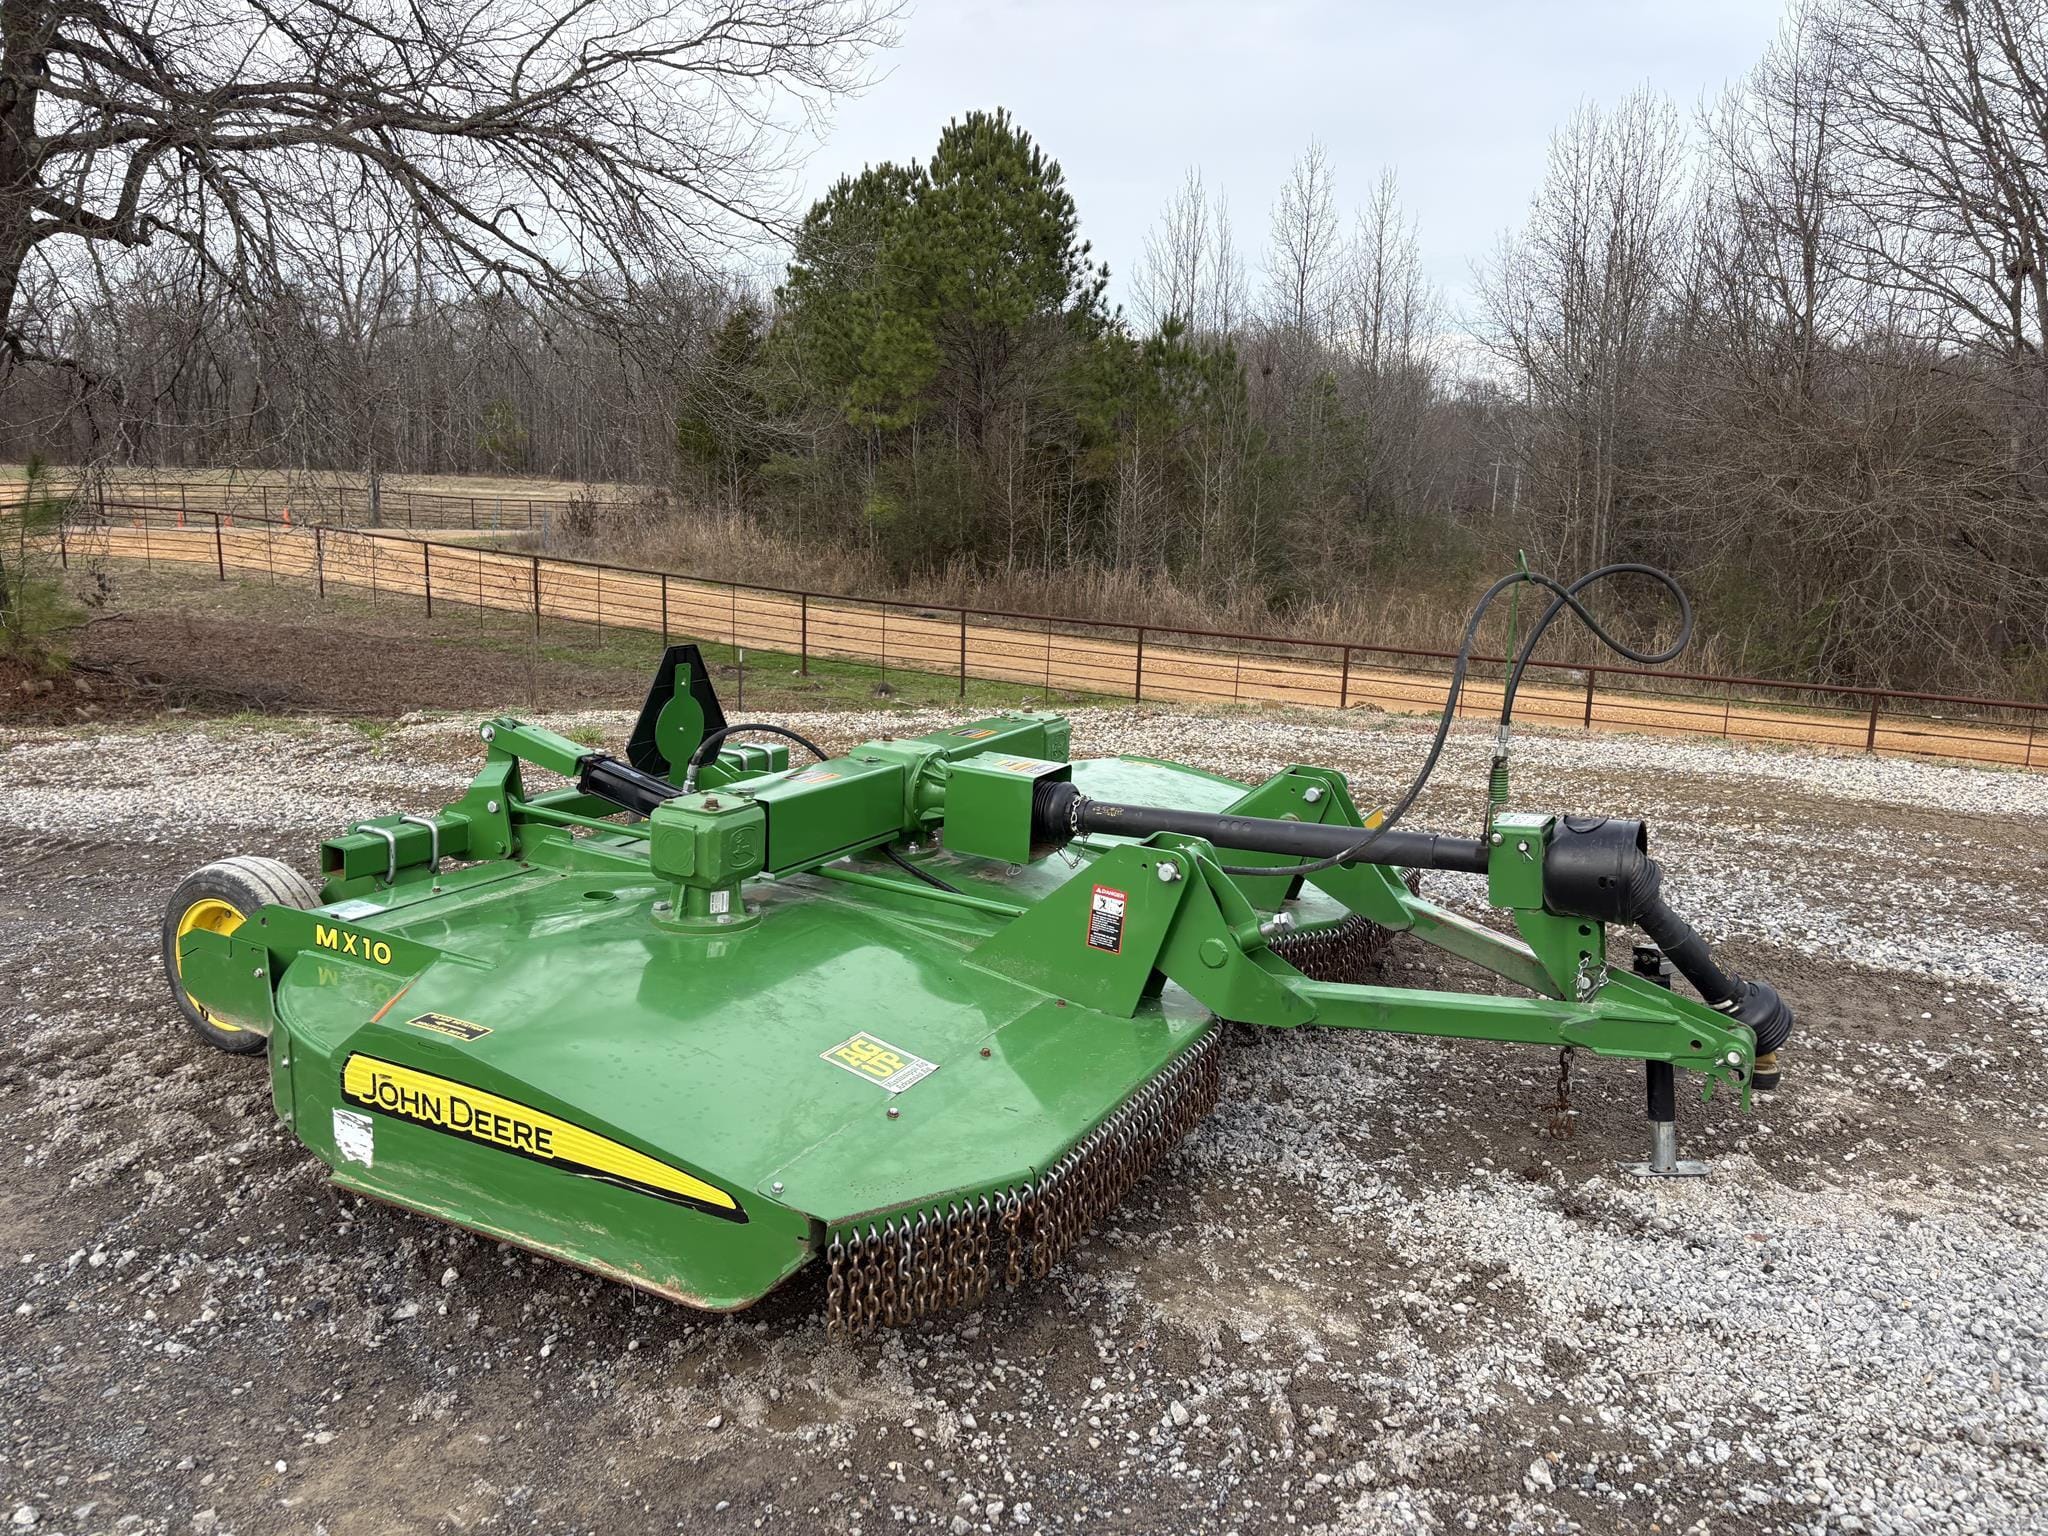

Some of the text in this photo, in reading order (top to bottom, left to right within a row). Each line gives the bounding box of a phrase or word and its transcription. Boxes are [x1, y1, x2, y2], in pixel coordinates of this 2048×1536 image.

[315, 924, 392, 965] MX10
[835, 1039, 884, 1067] AG
[861, 1051, 906, 1077] UP
[363, 1073, 554, 1156] JOHN DEERE
